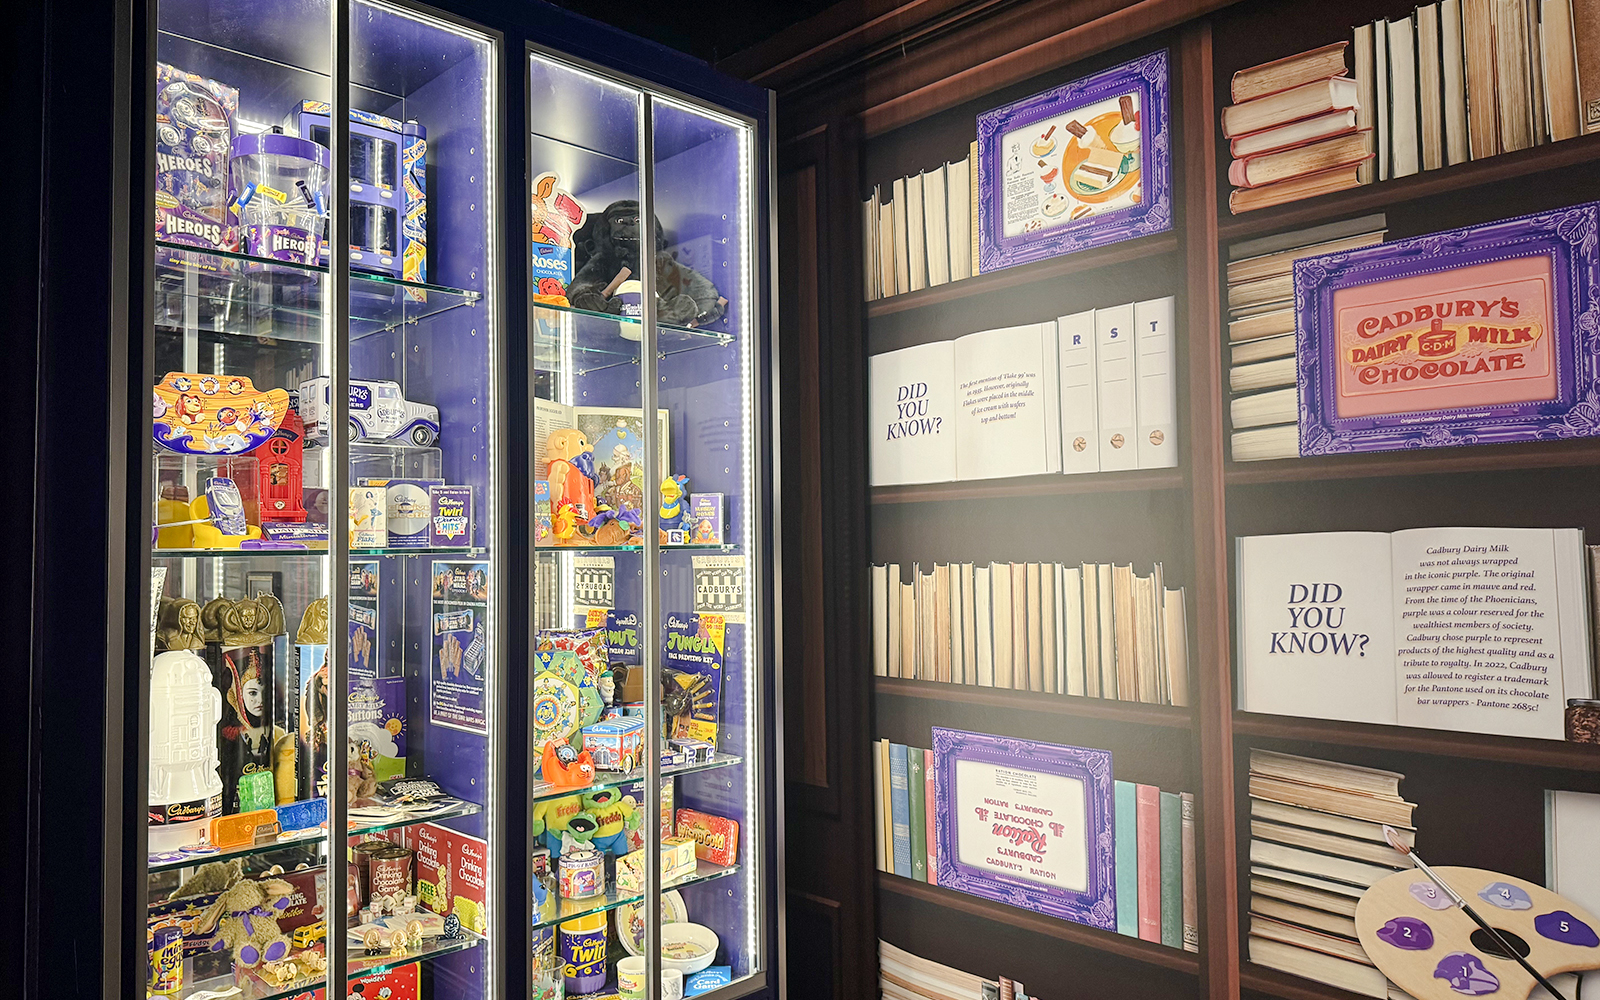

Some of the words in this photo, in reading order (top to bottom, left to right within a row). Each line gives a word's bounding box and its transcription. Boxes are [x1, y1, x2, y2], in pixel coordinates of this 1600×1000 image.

[157, 153, 212, 177] HEROES
[166, 214, 221, 245] HEROES
[273, 234, 316, 258] HEROES
[1357, 297, 1520, 339] CADBURY'S
[1110, 327, 1118, 339] S
[1150, 321, 1158, 332] T
[1073, 334, 1081, 345] R
[1352, 334, 1412, 363] DAIRY
[1468, 326, 1533, 344] MILK
[1359, 353, 1525, 385] CHOCOLATE
[898, 382, 928, 402] DID
[897, 399, 929, 420] YOU
[886, 417, 942, 441] KNOW?
[439, 507, 463, 516] Twirl
[1426, 547, 1460, 555] Cadbury
[1463, 546, 1487, 554] Dairy
[1482, 558, 1518, 566] wrapped
[1452, 571, 1481, 579] purple.
[1501, 570, 1534, 579] original
[1288, 583, 1343, 604] DID
[1406, 585, 1439, 593] wrapper
[1460, 595, 1469, 604] of
[1485, 596, 1537, 605] Phoenicians,
[1287, 607, 1346, 629] YOU
[1403, 609, 1427, 618] purple
[1515, 609, 1529, 618] for
[1492, 621, 1501, 631] of
[1502, 623, 1533, 632] society.
[667, 632, 715, 654] JUNGLE
[1269, 632, 1370, 657] KNOW?
[1407, 634, 1440, 642] Cadbury
[1465, 635, 1492, 643] purple
[1398, 647, 1430, 656] products
[1432, 646, 1441, 655] of
[1456, 647, 1485, 656] highest
[1487, 648, 1516, 657] quality
[1510, 662, 1548, 673] Cadbury
[1465, 674, 1495, 682] register
[1504, 676, 1549, 685] trademark
[1404, 685, 1416, 694] for
[1497, 687, 1508, 695] its
[1510, 690, 1549, 699] chocolate
[1417, 697, 1430, 705] bar
[1433, 699, 1469, 707] wrappers
[1477, 699, 1510, 709] Pantone
[1512, 704, 1539, 712] 2685c!
[984, 798, 1008, 808] RATION
[1015, 804, 1053, 816] CADBURY'S
[994, 811, 1043, 828] CHOCOLATE
[704, 830, 725, 851] Gold
[992, 823, 1047, 855] Ration
[419, 840, 437, 858] Drinking
[997, 847, 1042, 863] CADBURY'S
[417, 851, 440, 869] Chocolate
[461, 857, 482, 877] Drinking
[986, 857, 1022, 871] CADBURY'S
[1030, 868, 1056, 879] RATION
[459, 868, 484, 888] Chocolate
[421, 881, 434, 896] FREE
[1427, 888, 1436, 898] 3
[1500, 889, 1511, 899] 4
[1403, 927, 1412, 938] 2
[1560, 921, 1569, 932] 5
[571, 945, 605, 962] Twirl
[1461, 966, 1468, 977] 1
